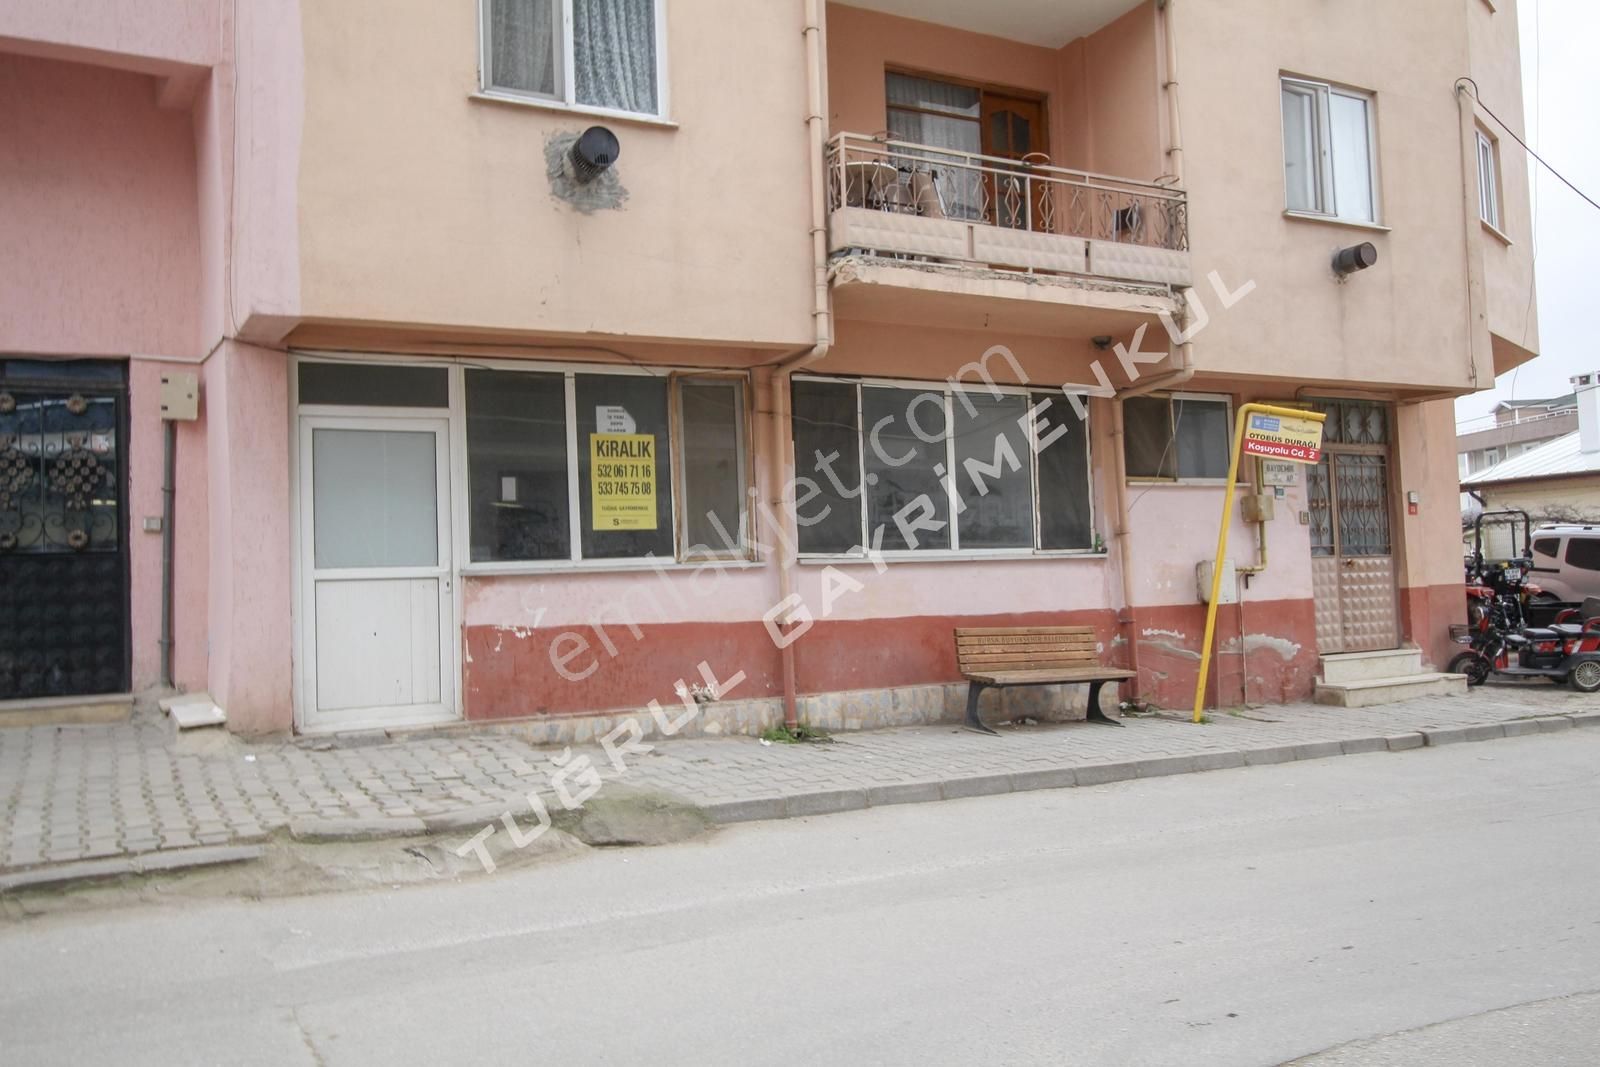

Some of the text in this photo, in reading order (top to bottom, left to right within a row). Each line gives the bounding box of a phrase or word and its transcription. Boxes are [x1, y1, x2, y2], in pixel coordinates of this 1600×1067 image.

[1248, 441, 1315, 459] Koşuyolu Cd. 2
[1284, 437, 1317, 449] DURAĞI
[597, 463, 651, 478] 532 061 71 16
[598, 481, 652, 495] 533 745 75 08
